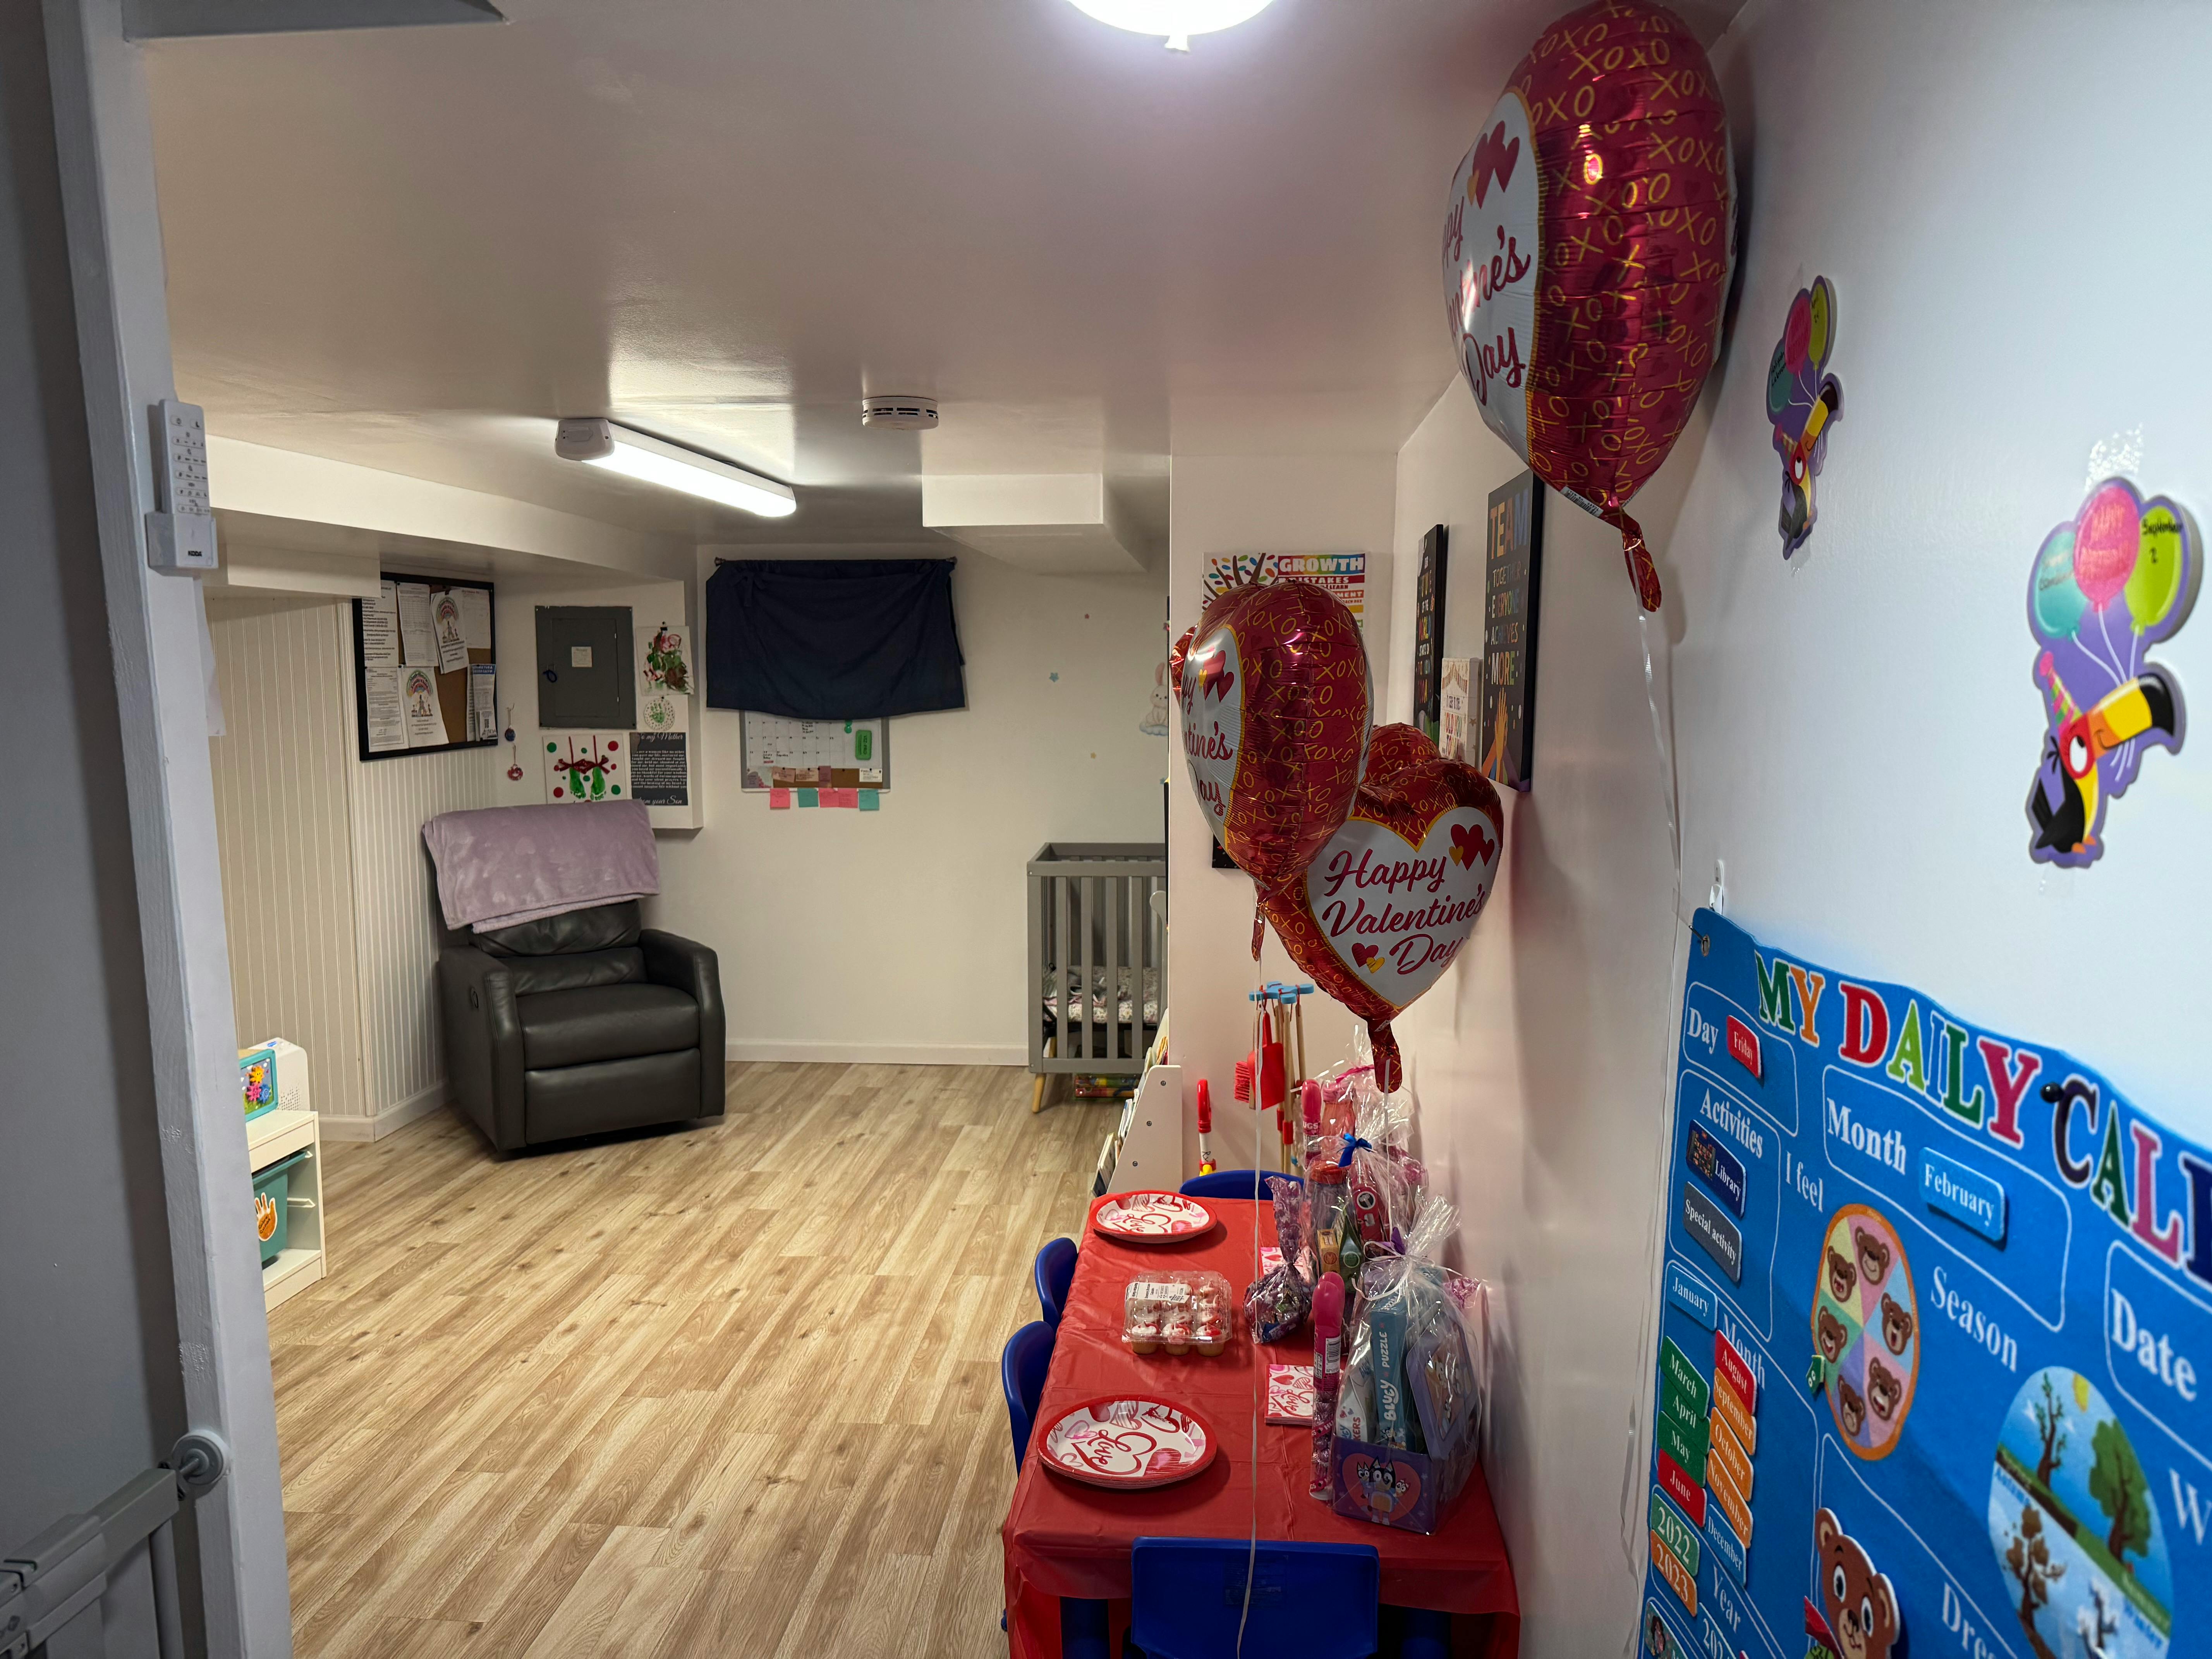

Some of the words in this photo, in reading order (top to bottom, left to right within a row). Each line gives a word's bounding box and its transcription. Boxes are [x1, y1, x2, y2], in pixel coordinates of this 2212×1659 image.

[1490, 487, 1528, 560] TEAM
[1279, 557, 1364, 572] GROWTH
[1493, 561, 1521, 588] TOGETHER
[1491, 622, 1518, 645] ACHIEVES
[1491, 651, 1515, 685] MORE
[1324, 848, 1447, 897] Happy
[1322, 884, 1485, 937] Valentine's
[1389, 933, 1464, 975] Day
[1687, 1007, 1718, 1054] Day
[1734, 1030, 1753, 1066] Friday
[1755, 950, 1825, 1048] MY
[1839, 981, 2042, 1149] DAILY
[1303, 1121, 1319, 1130] UGS
[1700, 1087, 1763, 1159] Activities
[1715, 1159, 1741, 1201] Library
[1786, 1151, 1791, 1185] I
[1797, 1161, 1823, 1213] feel
[1826, 1097, 1906, 1175] Month
[1924, 1163, 1994, 1226] February
[1686, 1199, 1711, 1235] Special
[1712, 1228, 1736, 1266] activity
[1673, 1276, 1710, 1317] January
[1930, 1266, 2017, 1372] Season
[1722, 1349, 1747, 1395] August
[1723, 1313, 1765, 1391] Month
[2111, 1288, 2197, 1402] Date
[1380, 1380, 1398, 1420] BLUEY
[1669, 1353, 1697, 1399] March
[1673, 1395, 1697, 1429] April
[1714, 1376, 1753, 1441] September
[1671, 1429, 1691, 1463] May
[1716, 1425, 1745, 1480] October
[1670, 1470, 1691, 1502] June
[1709, 1459, 1748, 1537] November
[1658, 1506, 1690, 1565] 2022
[1707, 1516, 1743, 1572] December
[1657, 1544, 1688, 1602] 2023
[1713, 1564, 1741, 1634] Year
[1703, 1618, 1729, 1659] 202
[1942, 1582, 1998, 1659] Dre
